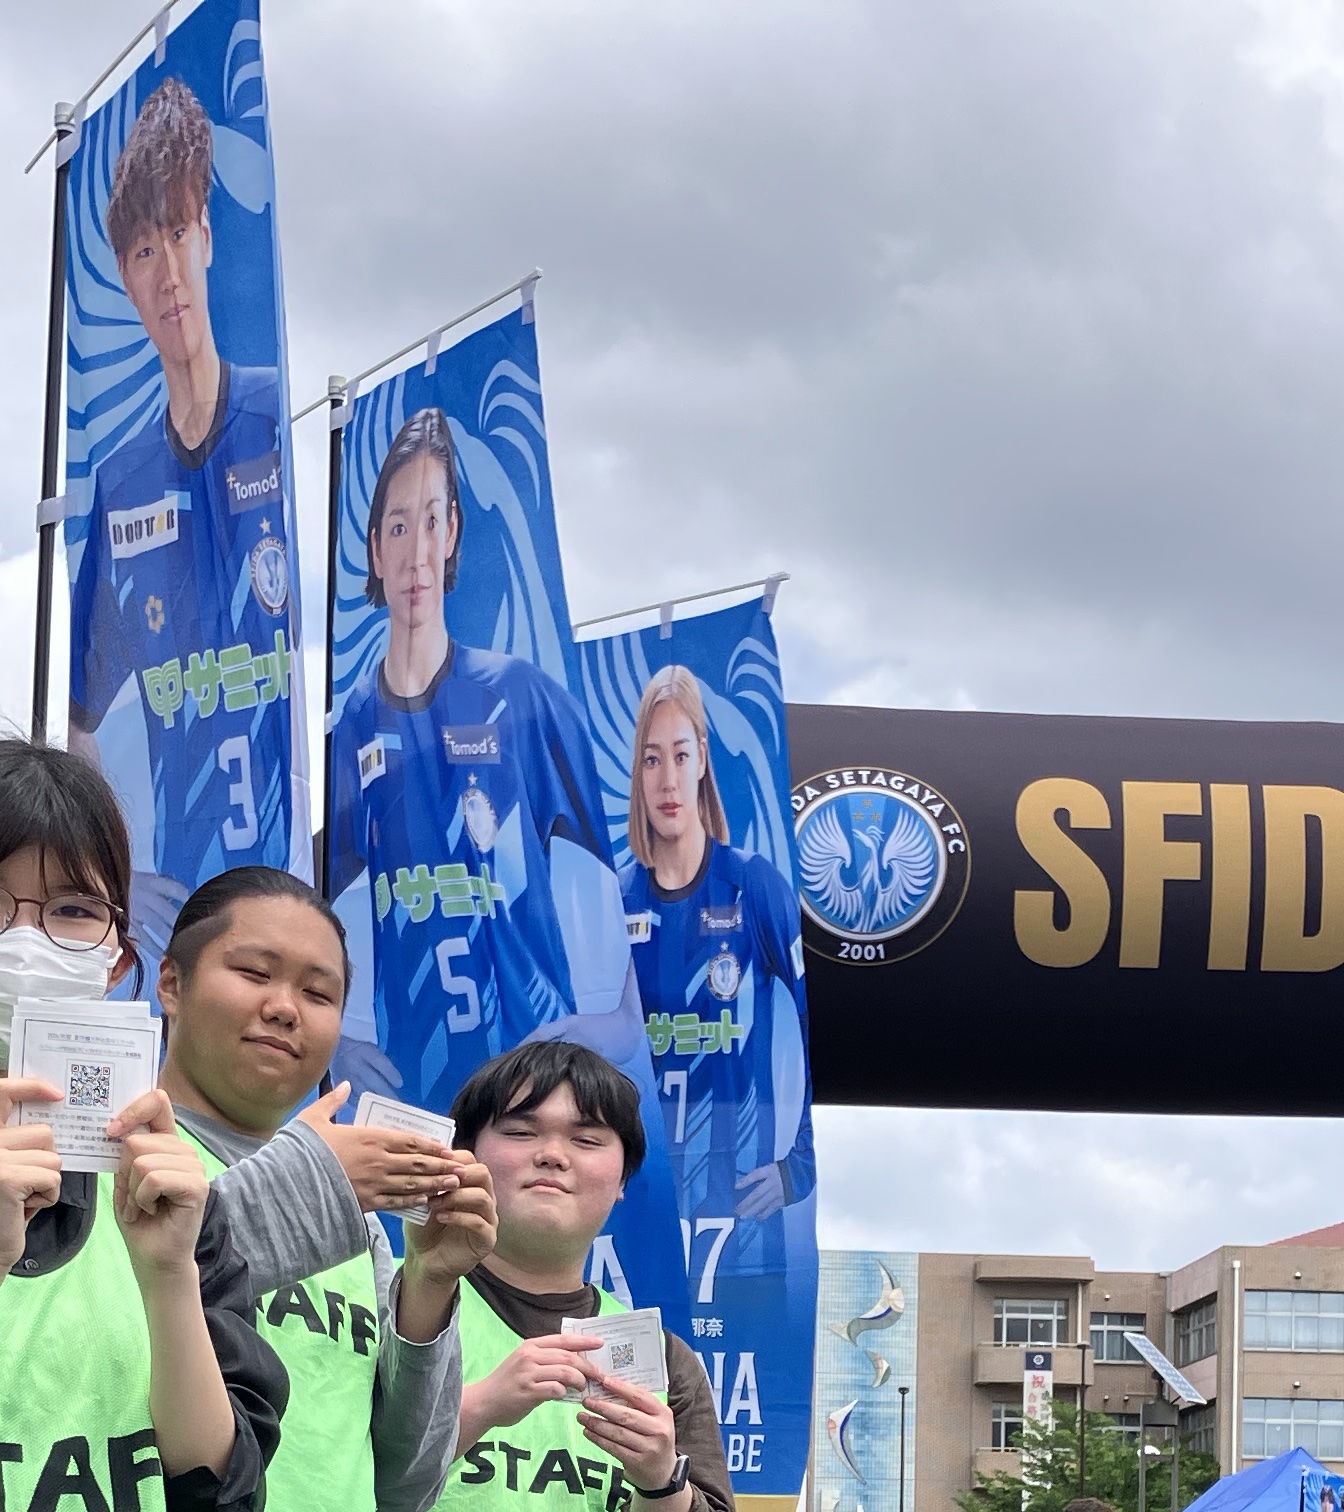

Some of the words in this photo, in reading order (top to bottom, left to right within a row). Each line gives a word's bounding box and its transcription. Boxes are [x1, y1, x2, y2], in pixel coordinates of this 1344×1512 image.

[112, 508, 175, 545] DOUTOR
[450, 735, 498, 757] Tomod's
[218, 735, 258, 851] 3
[824, 770, 947, 819] SETAGAYA
[942, 822, 966, 854] FC
[392, 863, 505, 924] サミット
[837, 942, 886, 960] 2001
[436, 936, 481, 1034] 5
[646, 1009, 744, 1056] サミット
[663, 1070, 687, 1144] 7
[1031, 1374, 1046, 1389] 祝
